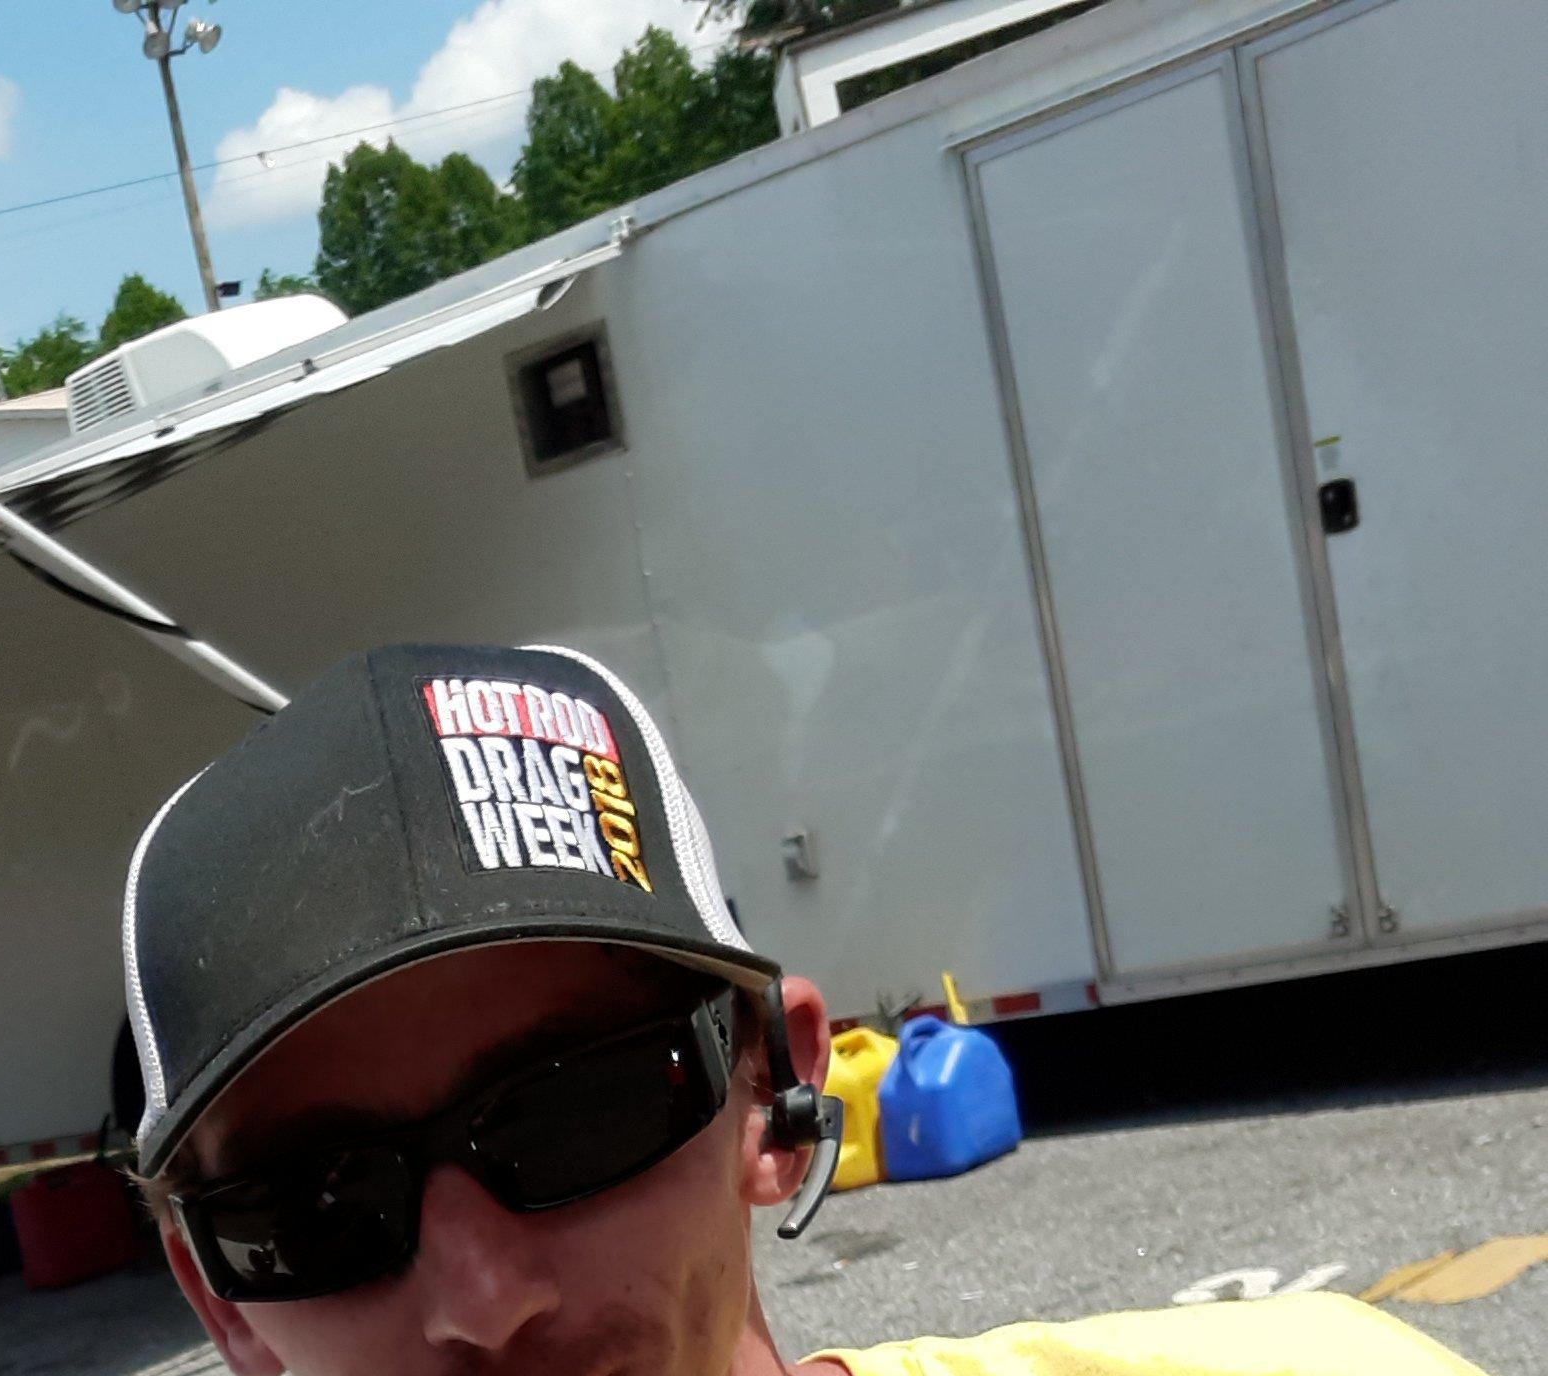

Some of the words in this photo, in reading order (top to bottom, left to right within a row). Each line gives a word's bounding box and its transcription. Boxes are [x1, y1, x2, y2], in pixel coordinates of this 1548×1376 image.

[432, 678, 523, 736] HOT
[521, 682, 609, 755] ROD
[440, 736, 591, 812] DRAG
[460, 801, 615, 878] WEEK
[583, 754, 652, 893] 2018
